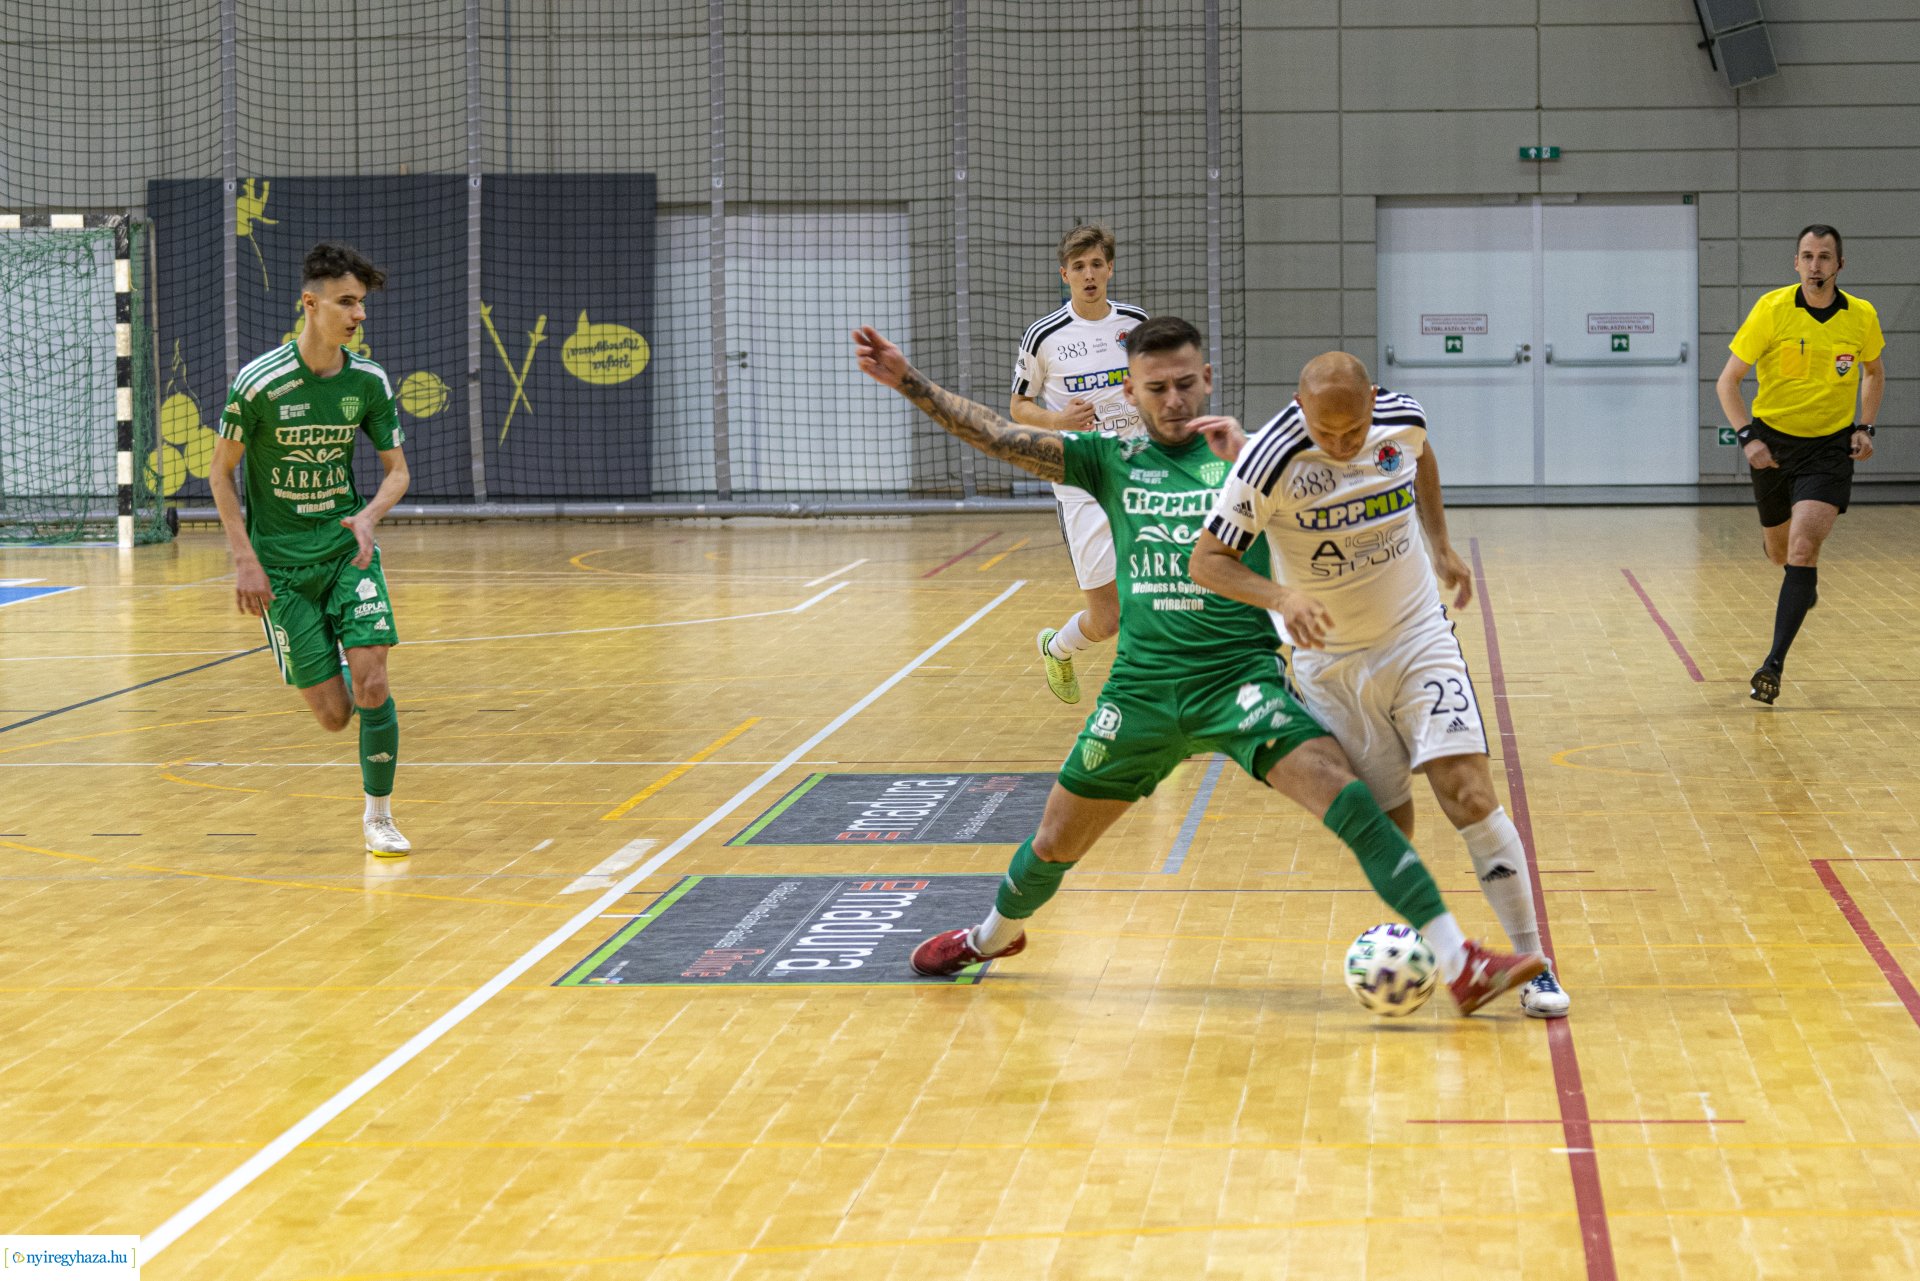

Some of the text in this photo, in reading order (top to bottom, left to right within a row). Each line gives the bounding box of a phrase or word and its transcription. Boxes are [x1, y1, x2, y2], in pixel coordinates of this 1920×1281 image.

[1057, 341, 1088, 361] 383
[1293, 468, 1337, 500] 383
[310, 492, 317, 500] &
[1169, 582, 1177, 593] &
[1153, 597, 1204, 611] NYÍRBÁTOR
[1423, 678, 1469, 716] 23
